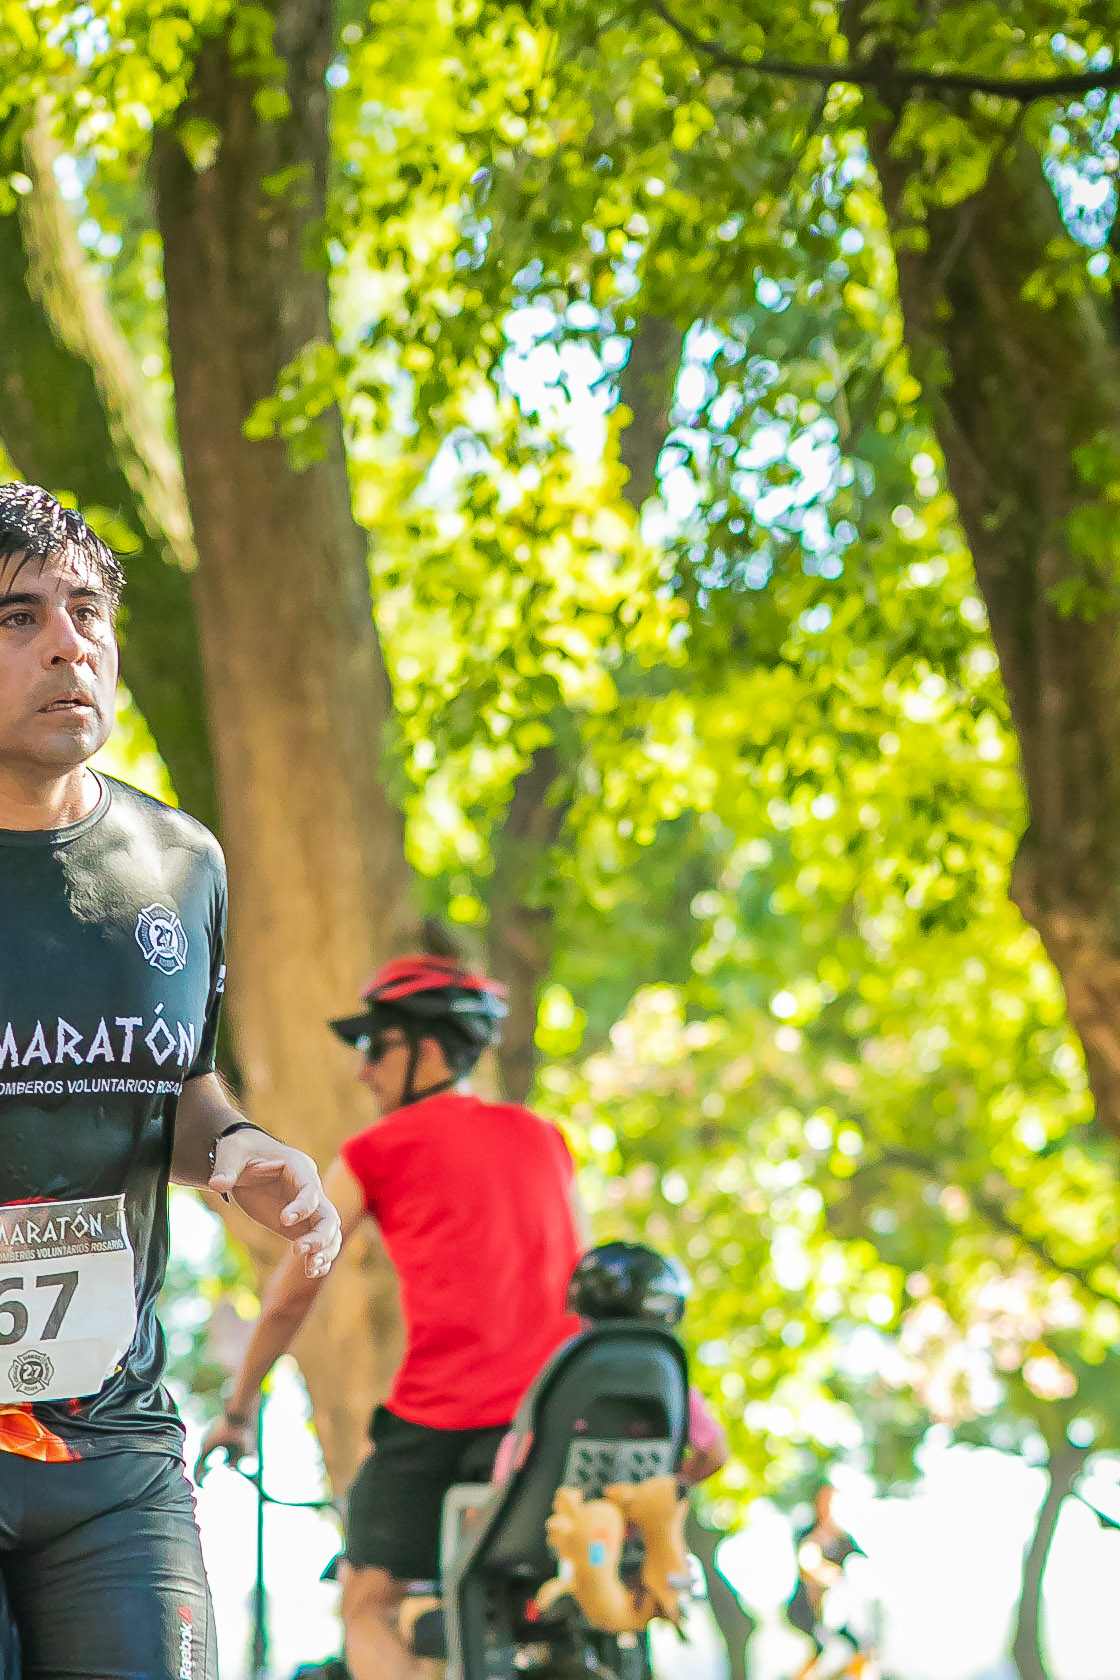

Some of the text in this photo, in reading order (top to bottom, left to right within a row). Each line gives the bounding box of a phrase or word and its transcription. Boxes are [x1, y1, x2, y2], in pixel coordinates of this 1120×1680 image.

[66, 1078, 154, 1095] VOLUNTARIOS
[36, 1242, 89, 1260] VOLUNTARIOS
[90, 1238, 125, 1252] ROSARIO
[22, 1363, 42, 1381] 27
